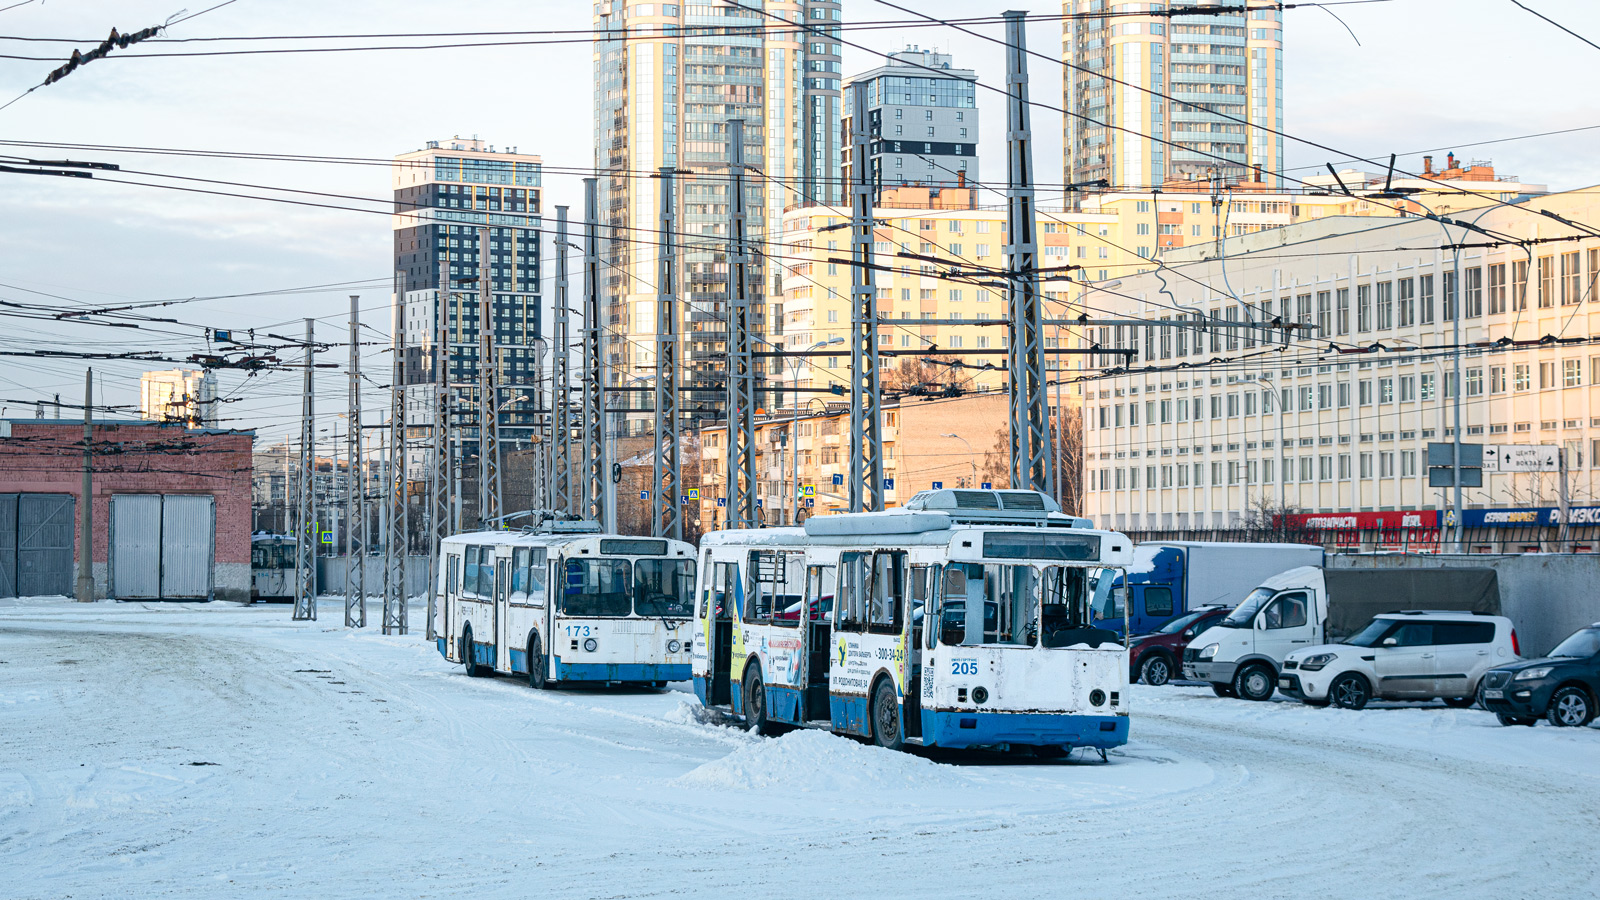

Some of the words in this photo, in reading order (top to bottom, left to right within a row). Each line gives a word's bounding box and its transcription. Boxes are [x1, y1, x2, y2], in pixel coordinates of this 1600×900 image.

[565, 625, 590, 637] 173
[878, 648, 903, 662] 300-34-24
[951, 662, 978, 675] 205
